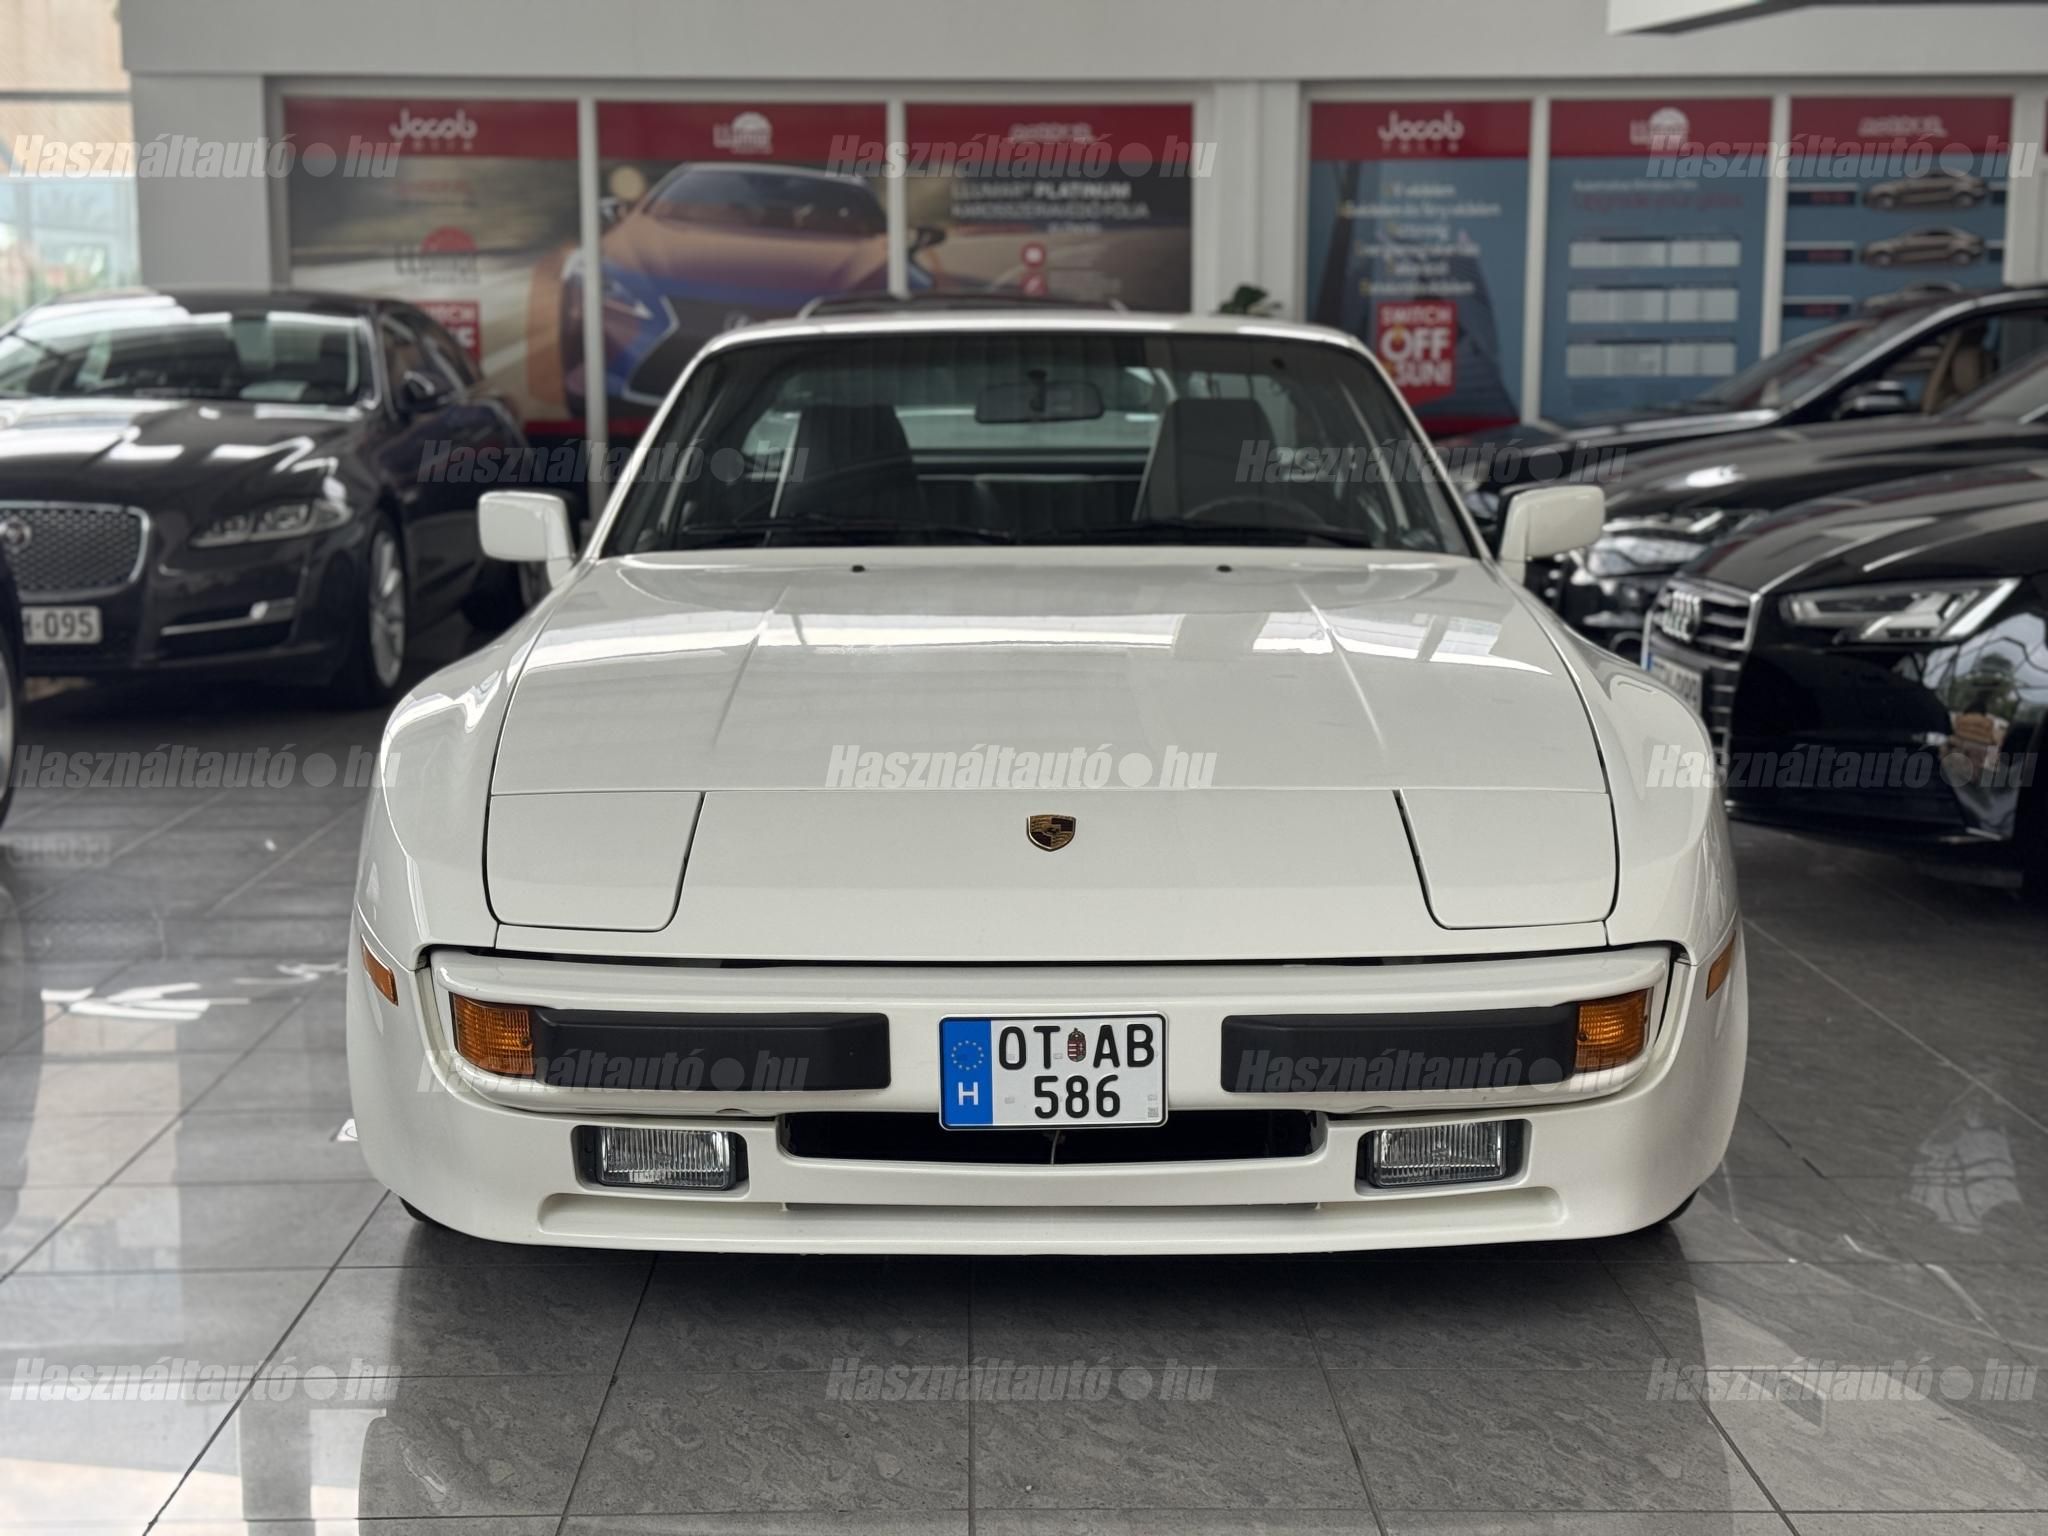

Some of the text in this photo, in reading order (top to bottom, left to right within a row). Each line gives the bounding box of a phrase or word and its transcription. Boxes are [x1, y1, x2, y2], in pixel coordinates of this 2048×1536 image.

[1381, 306, 1451, 325] SWITCH
[1381, 326, 1449, 360] OFF
[998, 1024, 1155, 1070] OT AB
[958, 1082, 979, 1105] H
[1034, 1074, 1120, 1118] 586
